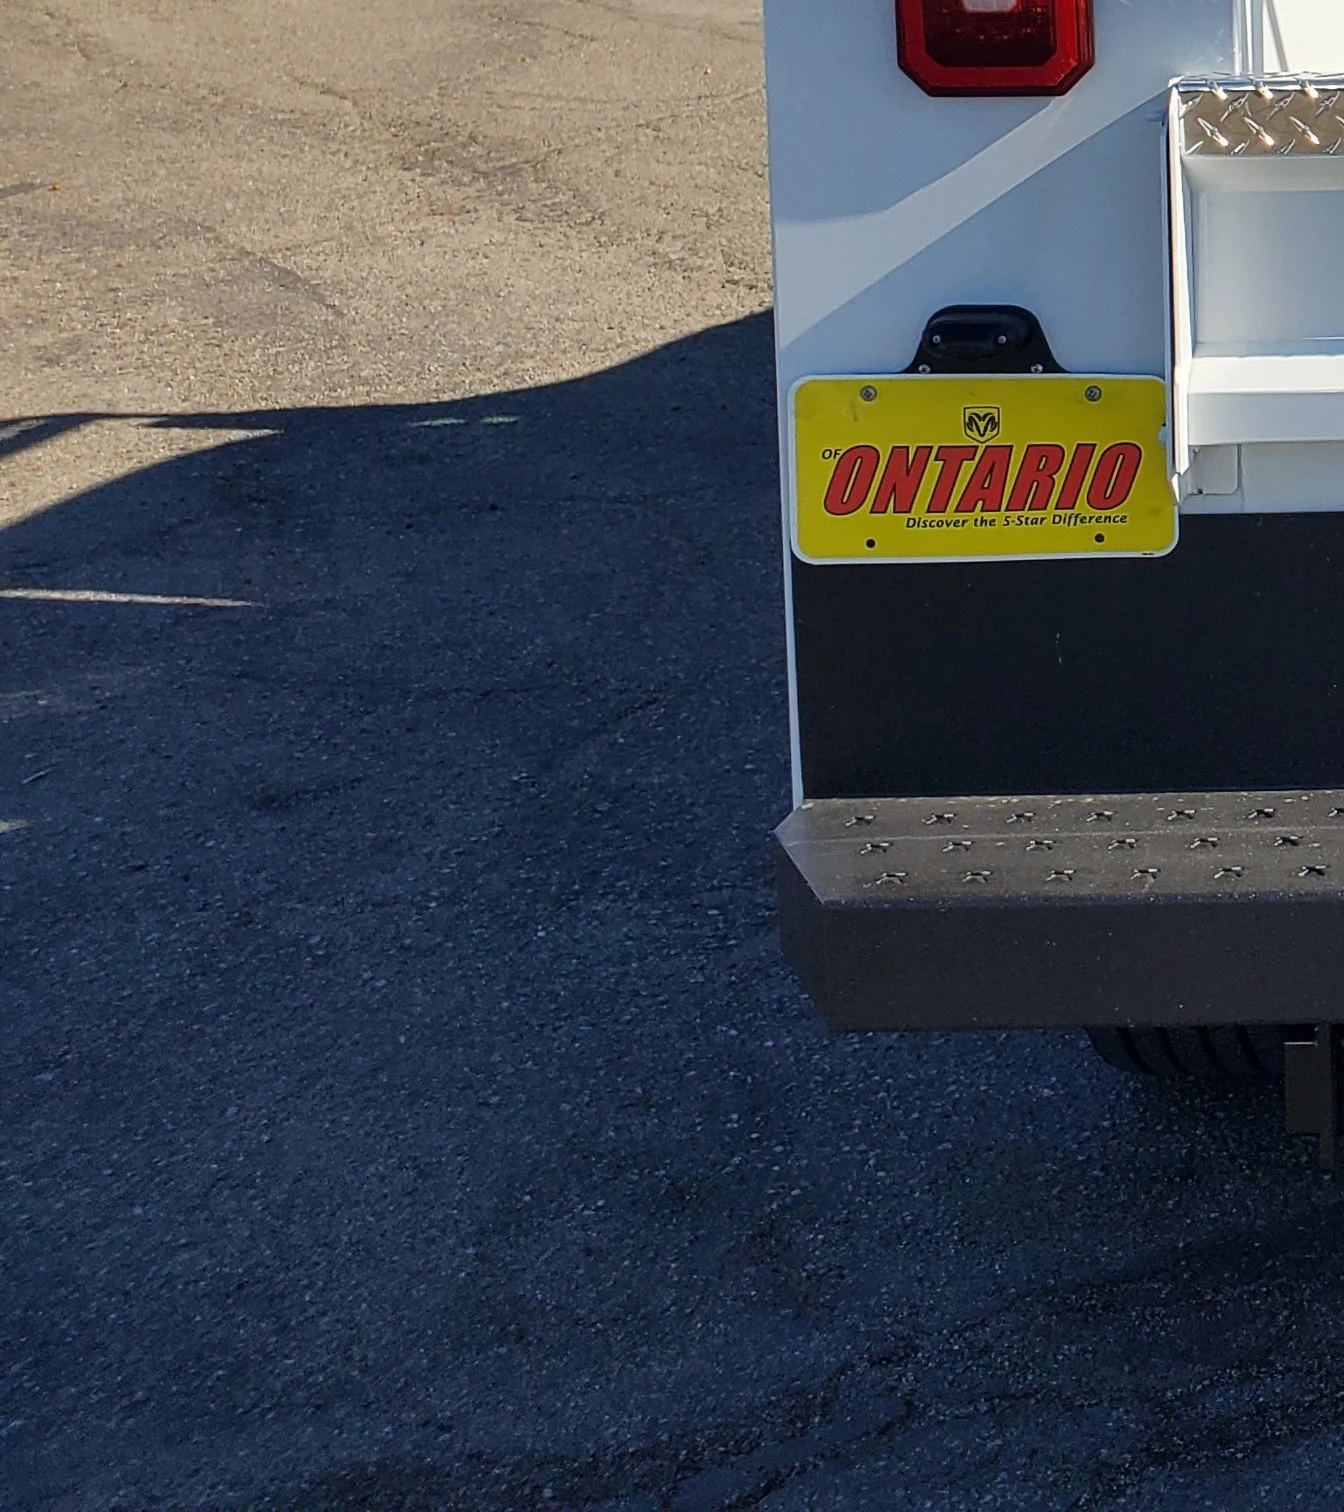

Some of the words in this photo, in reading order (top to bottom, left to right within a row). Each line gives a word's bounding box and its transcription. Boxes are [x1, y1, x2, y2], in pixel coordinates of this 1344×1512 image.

[821, 448, 842, 460] OF
[823, 441, 1143, 516] ONTARIO
[905, 517, 969, 529] Discover
[973, 515, 997, 528] the
[1002, 514, 1047, 527] 5-Star
[1051, 512, 1128, 527] Difference
